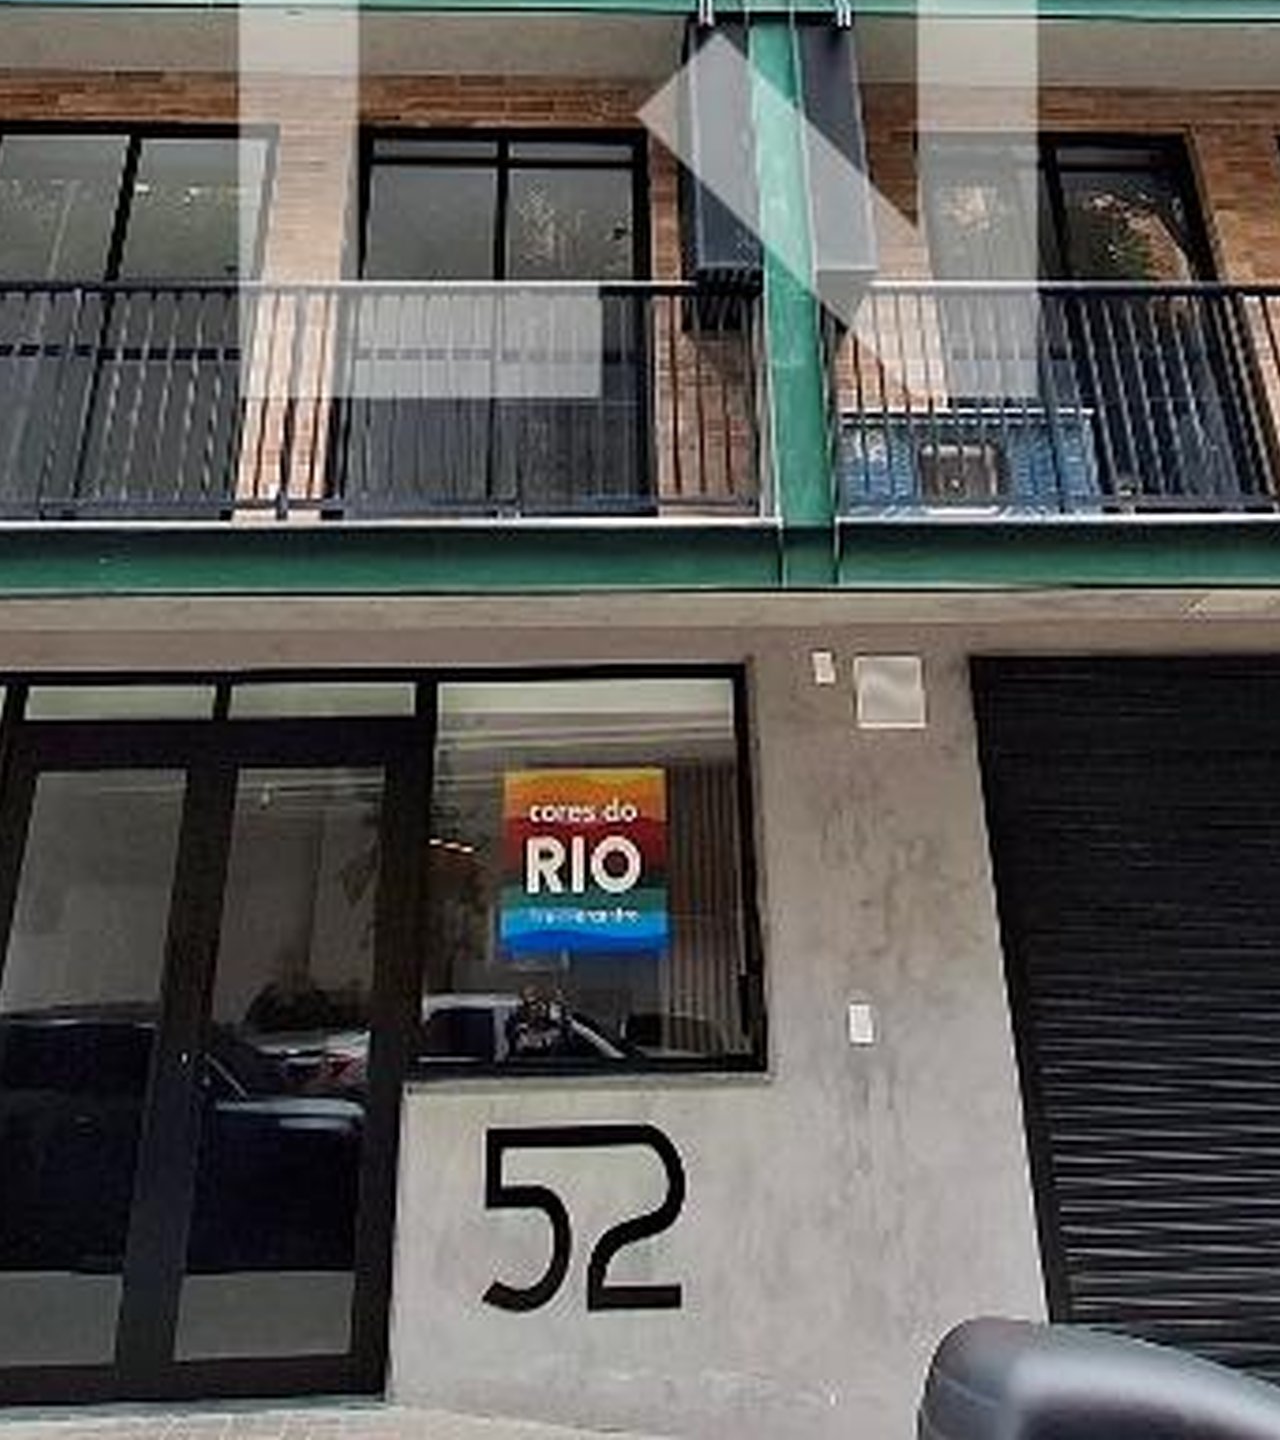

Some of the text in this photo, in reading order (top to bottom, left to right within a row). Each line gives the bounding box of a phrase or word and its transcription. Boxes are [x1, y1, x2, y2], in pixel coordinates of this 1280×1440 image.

[529, 797, 638, 823] cores do
[526, 835, 642, 894] RIO
[482, 1125, 685, 1312] 52
